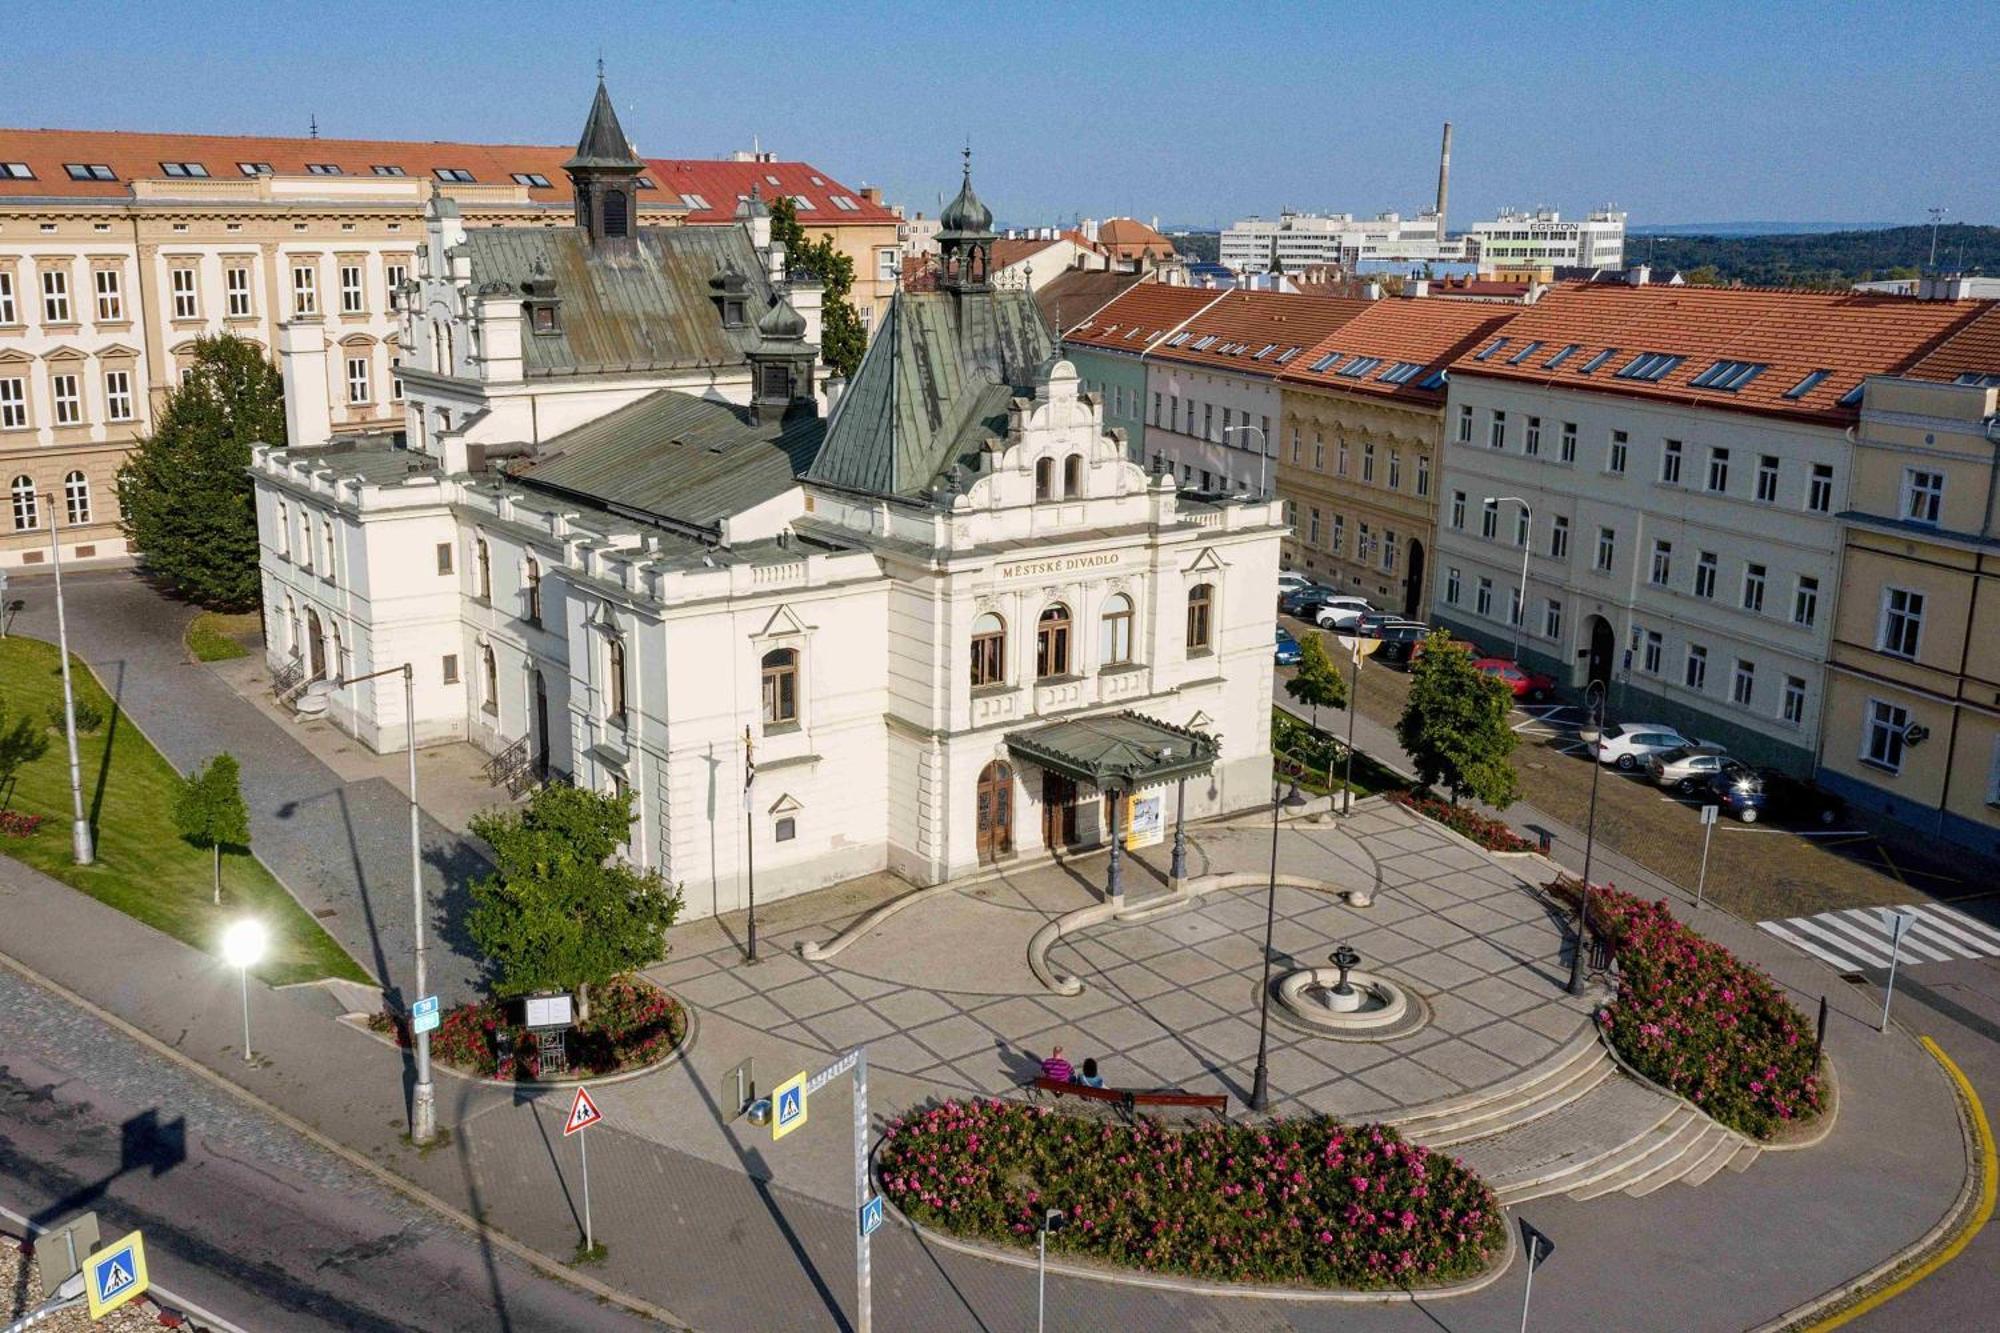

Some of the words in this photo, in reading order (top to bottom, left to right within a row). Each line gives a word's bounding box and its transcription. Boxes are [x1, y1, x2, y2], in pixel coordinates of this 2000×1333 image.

[1530, 223, 1578, 231] EGSTON
[1003, 561, 1062, 578] MĚSTSKÉ
[1066, 554, 1119, 569] DIVADLO
